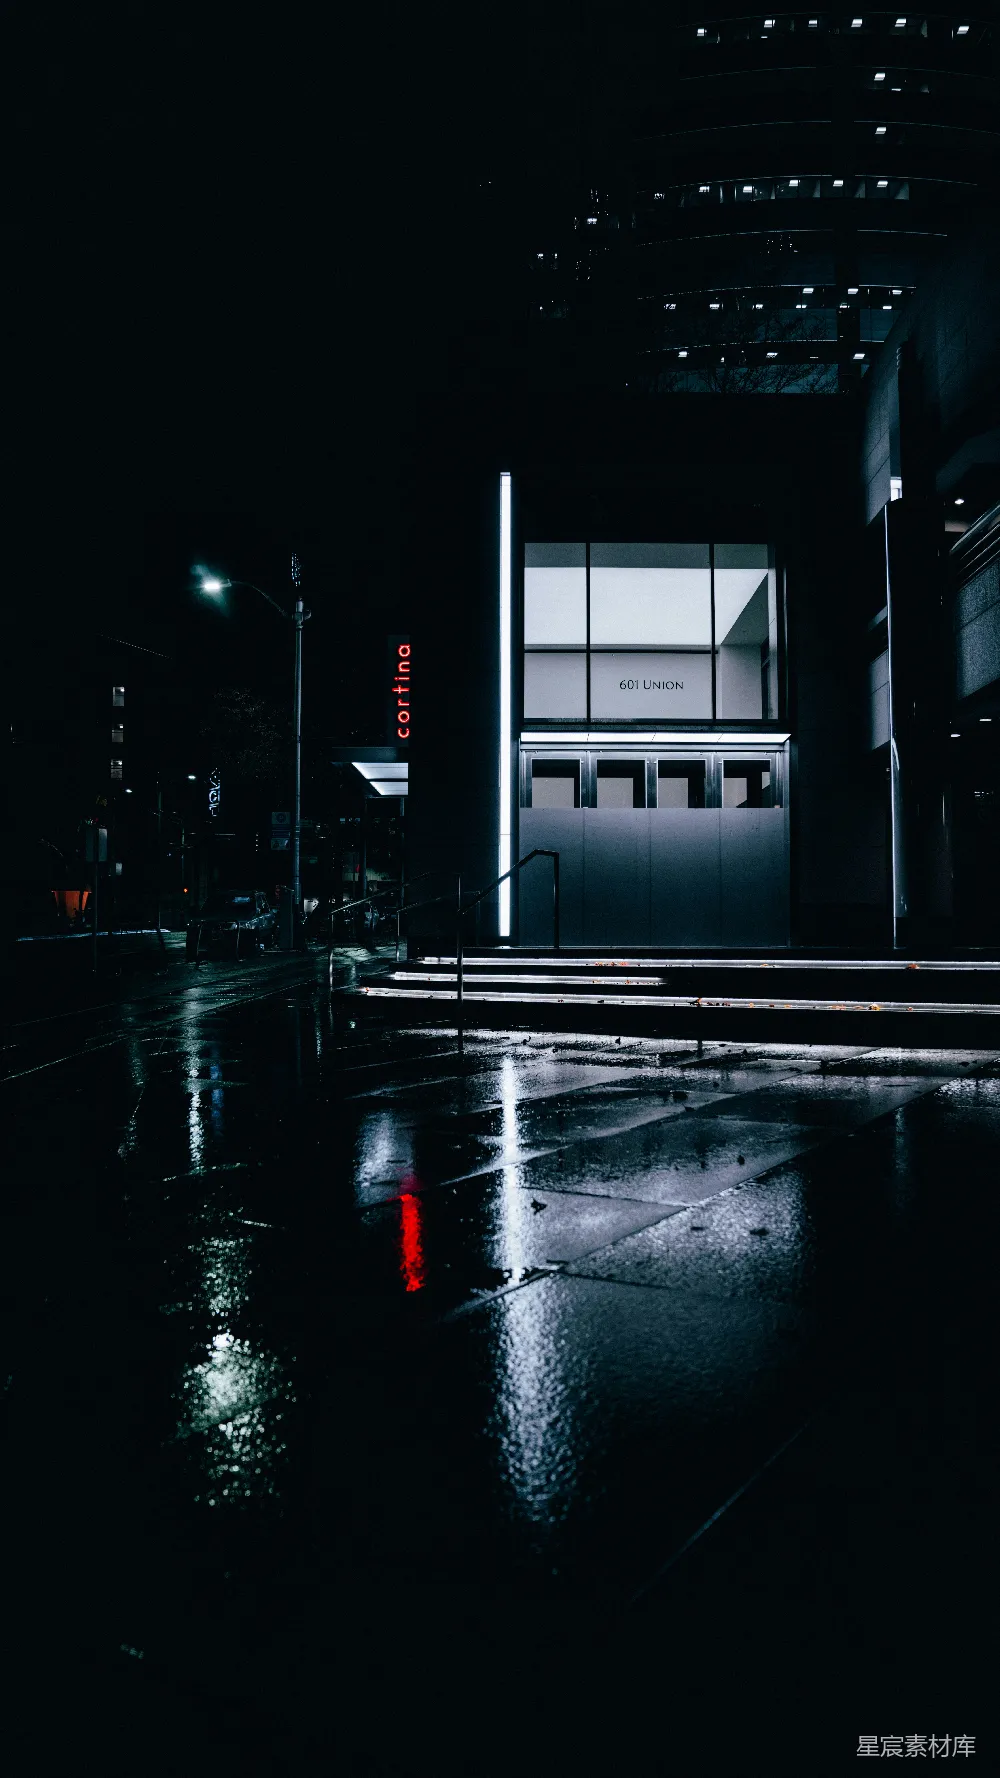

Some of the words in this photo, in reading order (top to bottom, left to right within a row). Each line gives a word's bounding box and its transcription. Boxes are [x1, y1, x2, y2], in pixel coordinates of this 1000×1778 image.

[391, 643, 411, 739] cortina
[619, 679, 639, 690] 601
[643, 679, 684, 690] UNION
